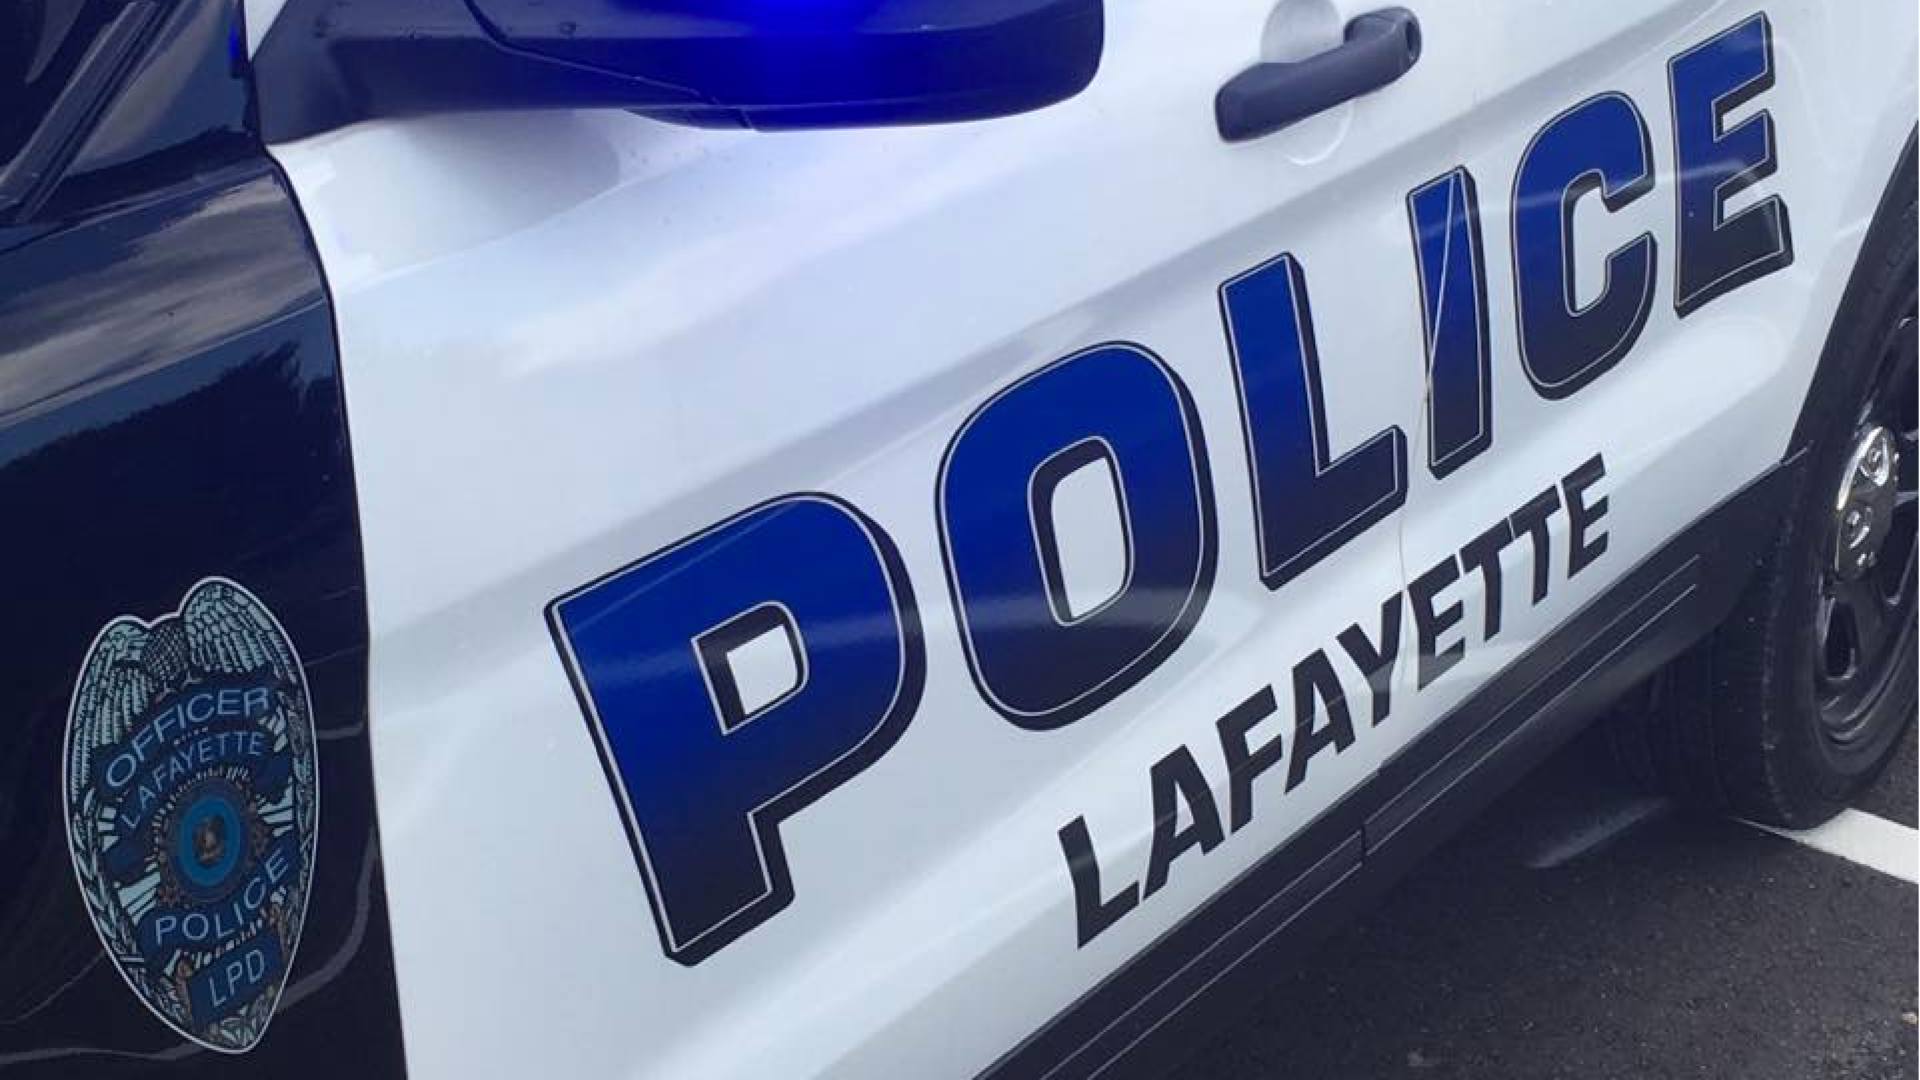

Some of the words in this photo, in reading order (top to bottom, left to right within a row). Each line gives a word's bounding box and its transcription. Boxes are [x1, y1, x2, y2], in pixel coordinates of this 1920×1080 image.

[545, 11, 1793, 966] POLICE
[105, 687, 270, 788] OFFICER
[1058, 452, 1609, 949] LAFAYETTE
[121, 731, 265, 829] LAFAYETTE
[155, 849, 289, 944] POLICE
[208, 948, 266, 1008] LPD
